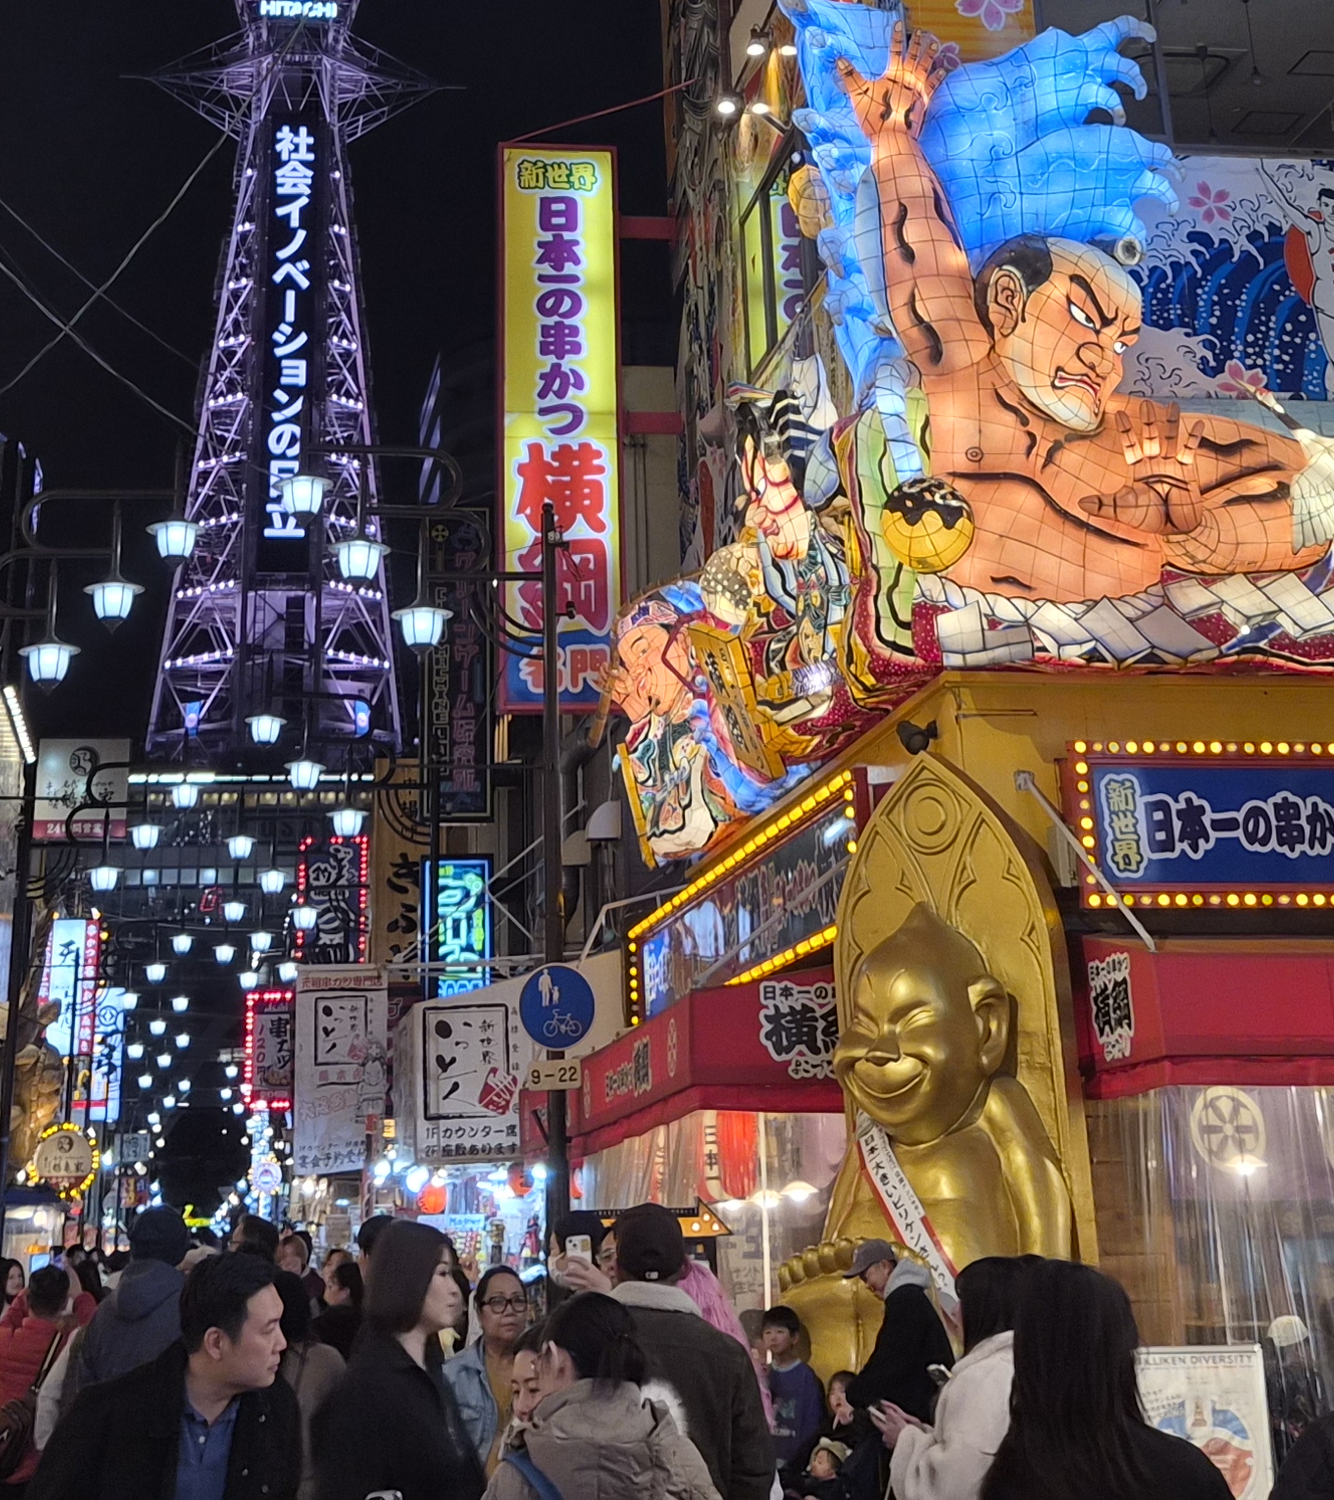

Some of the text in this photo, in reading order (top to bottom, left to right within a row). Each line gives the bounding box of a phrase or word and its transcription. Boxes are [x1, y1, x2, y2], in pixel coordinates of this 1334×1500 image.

[259, 0, 338, 19] HITACHI
[517, 160, 597, 192] 新世界
[535, 195, 585, 436] 日本一の串かつ
[263, 124, 315, 539] 社会イノベーションの日立
[1105, 779, 1143, 875] 新世界
[762, 984, 837, 1002] 日本一の
[530, 1064, 579, 1086] 9-22
[1190, 1354, 1253, 1365] DIVERSITY
